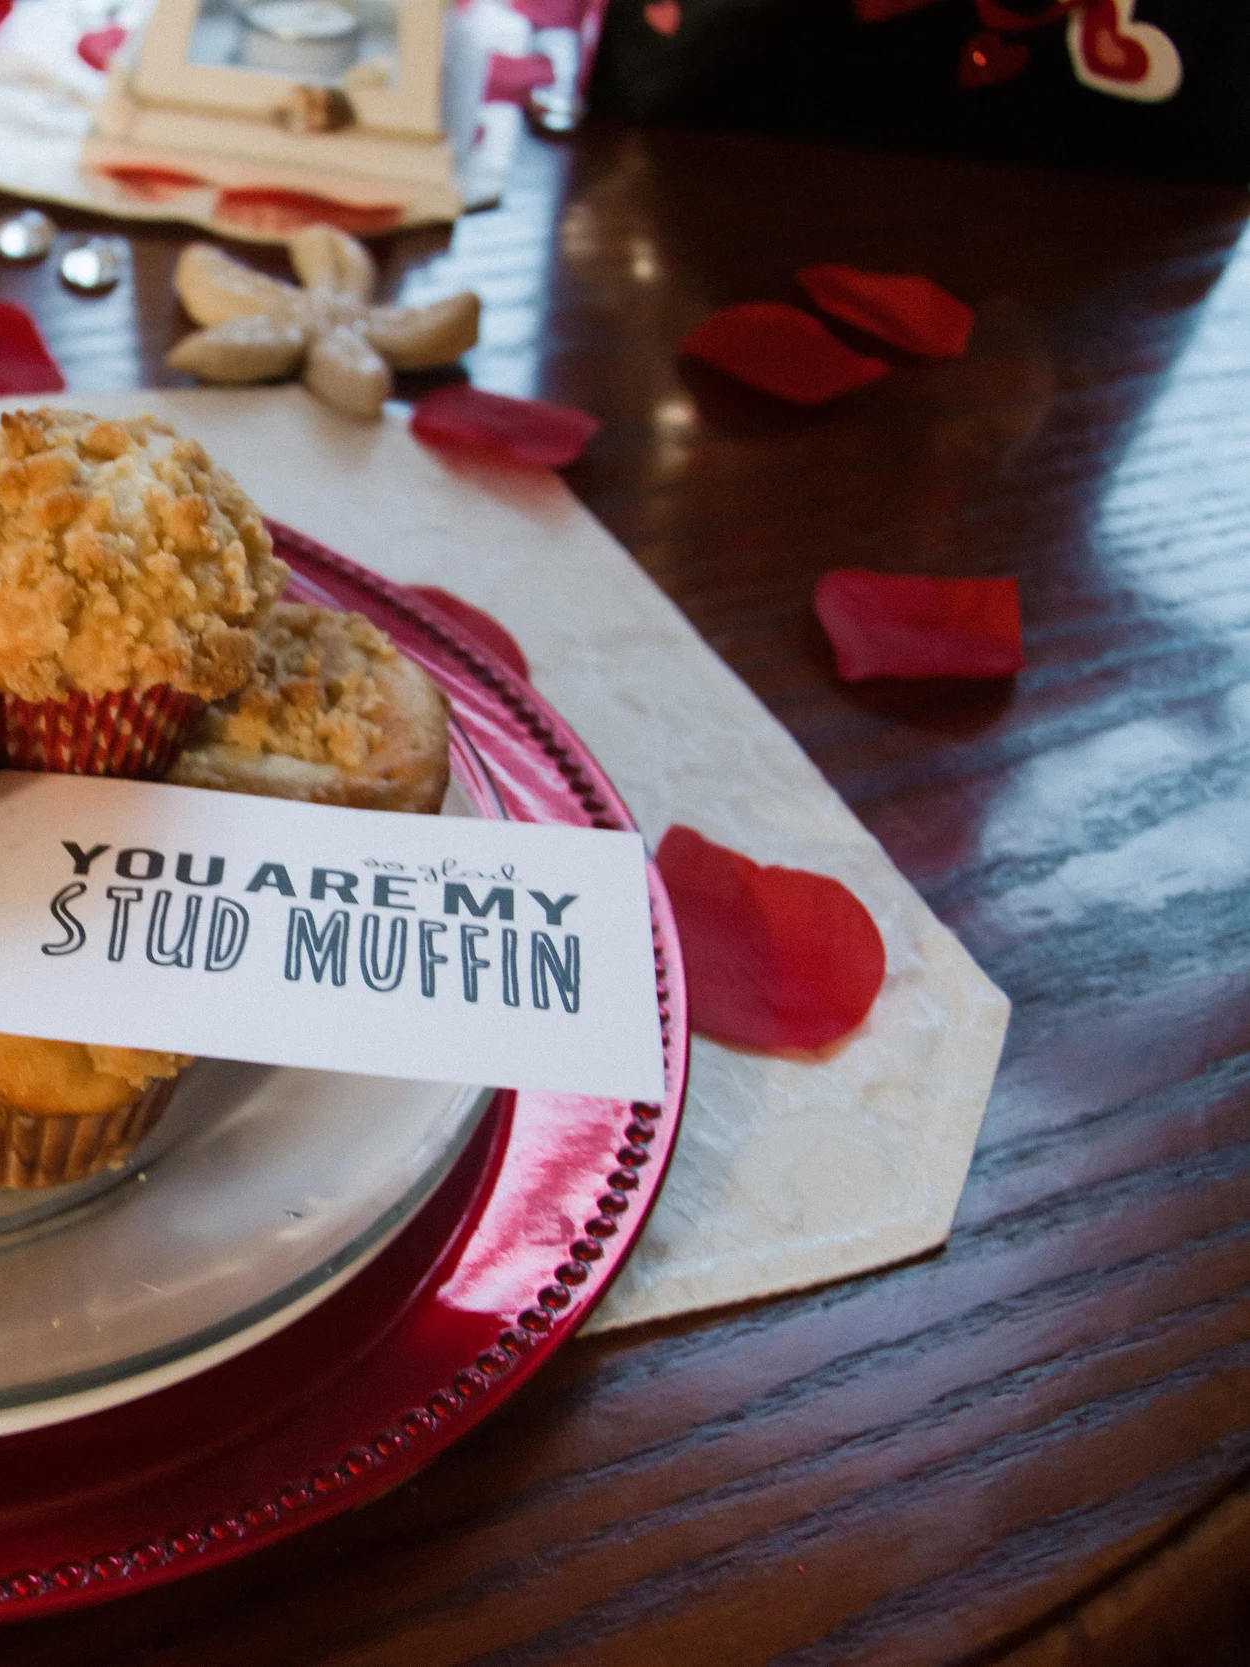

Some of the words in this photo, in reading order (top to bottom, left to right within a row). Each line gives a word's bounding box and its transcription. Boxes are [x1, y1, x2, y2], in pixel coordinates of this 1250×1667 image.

[60, 840, 226, 887] YOU
[245, 862, 417, 911] ARE
[443, 882, 580, 926] MY
[416, 857, 521, 884] glad
[40, 882, 250, 972] STUD
[283, 907, 581, 1013] MUFFIN
